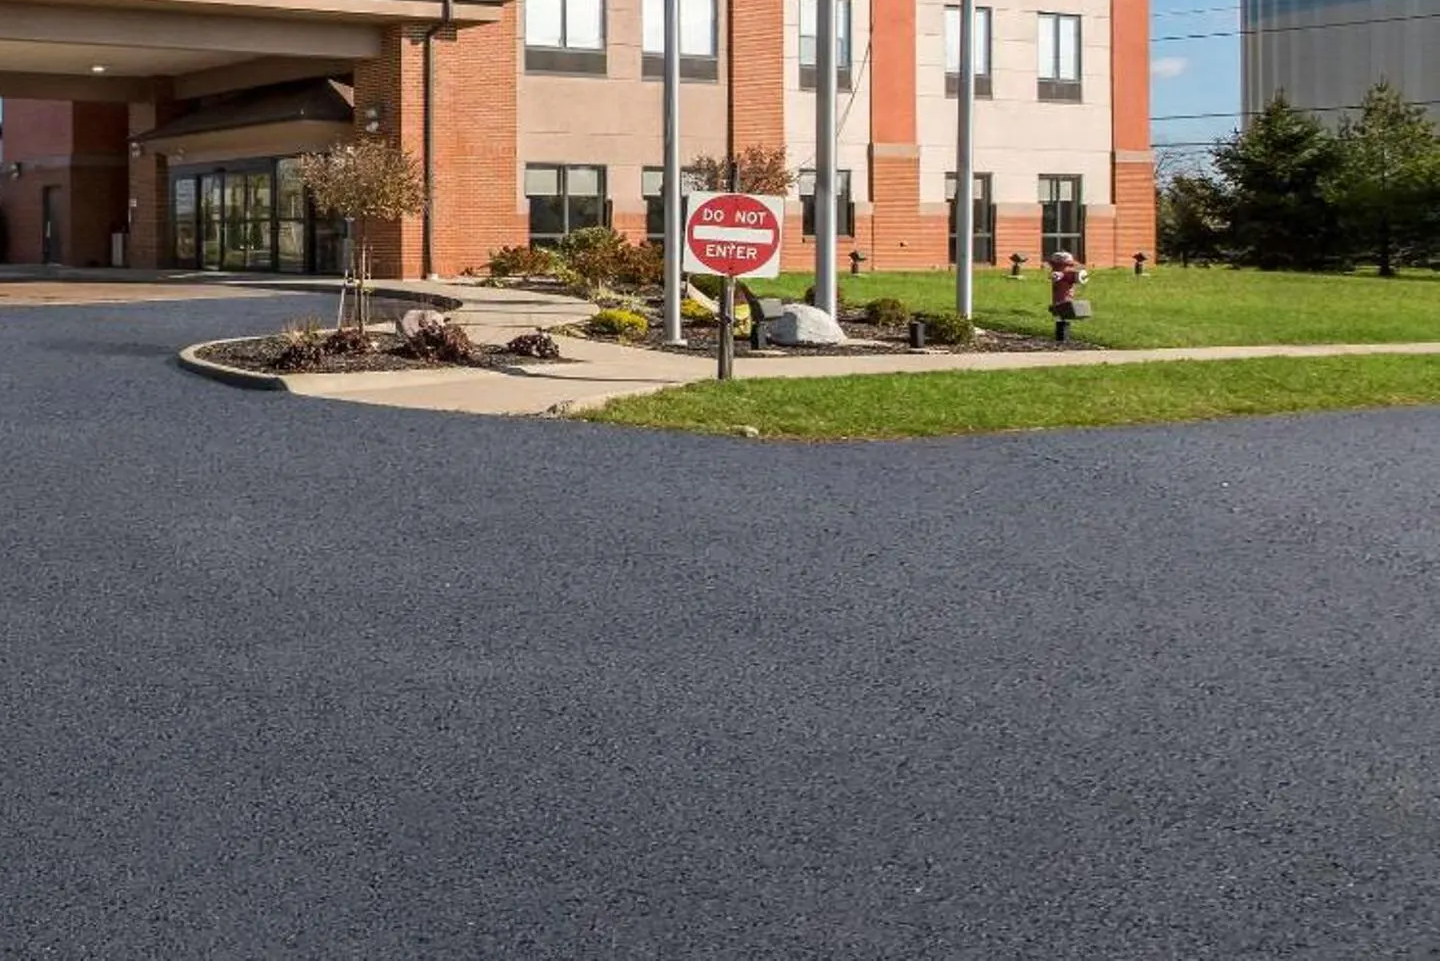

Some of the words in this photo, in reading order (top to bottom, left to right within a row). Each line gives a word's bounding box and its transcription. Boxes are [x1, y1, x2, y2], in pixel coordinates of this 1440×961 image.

[703, 208, 725, 222] DO
[734, 210, 766, 226] NOT
[706, 244, 758, 260] ENTER
